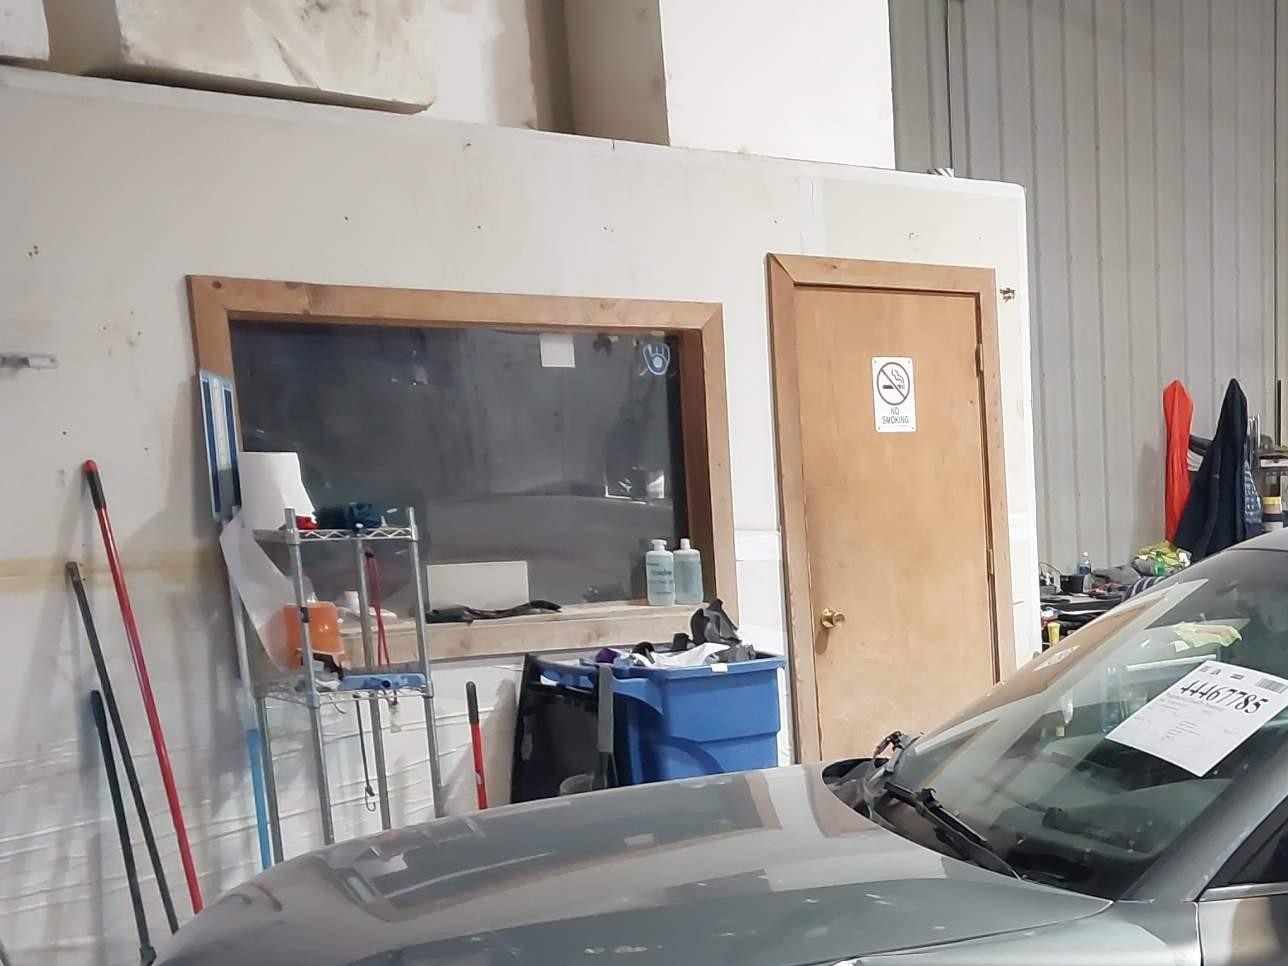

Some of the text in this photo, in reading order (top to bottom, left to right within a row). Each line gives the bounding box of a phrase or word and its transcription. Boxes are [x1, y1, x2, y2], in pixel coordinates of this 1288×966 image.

[890, 407, 899, 415] NO
[881, 416, 909, 424] SMOKING
[1180, 680, 1268, 713] 44467785
